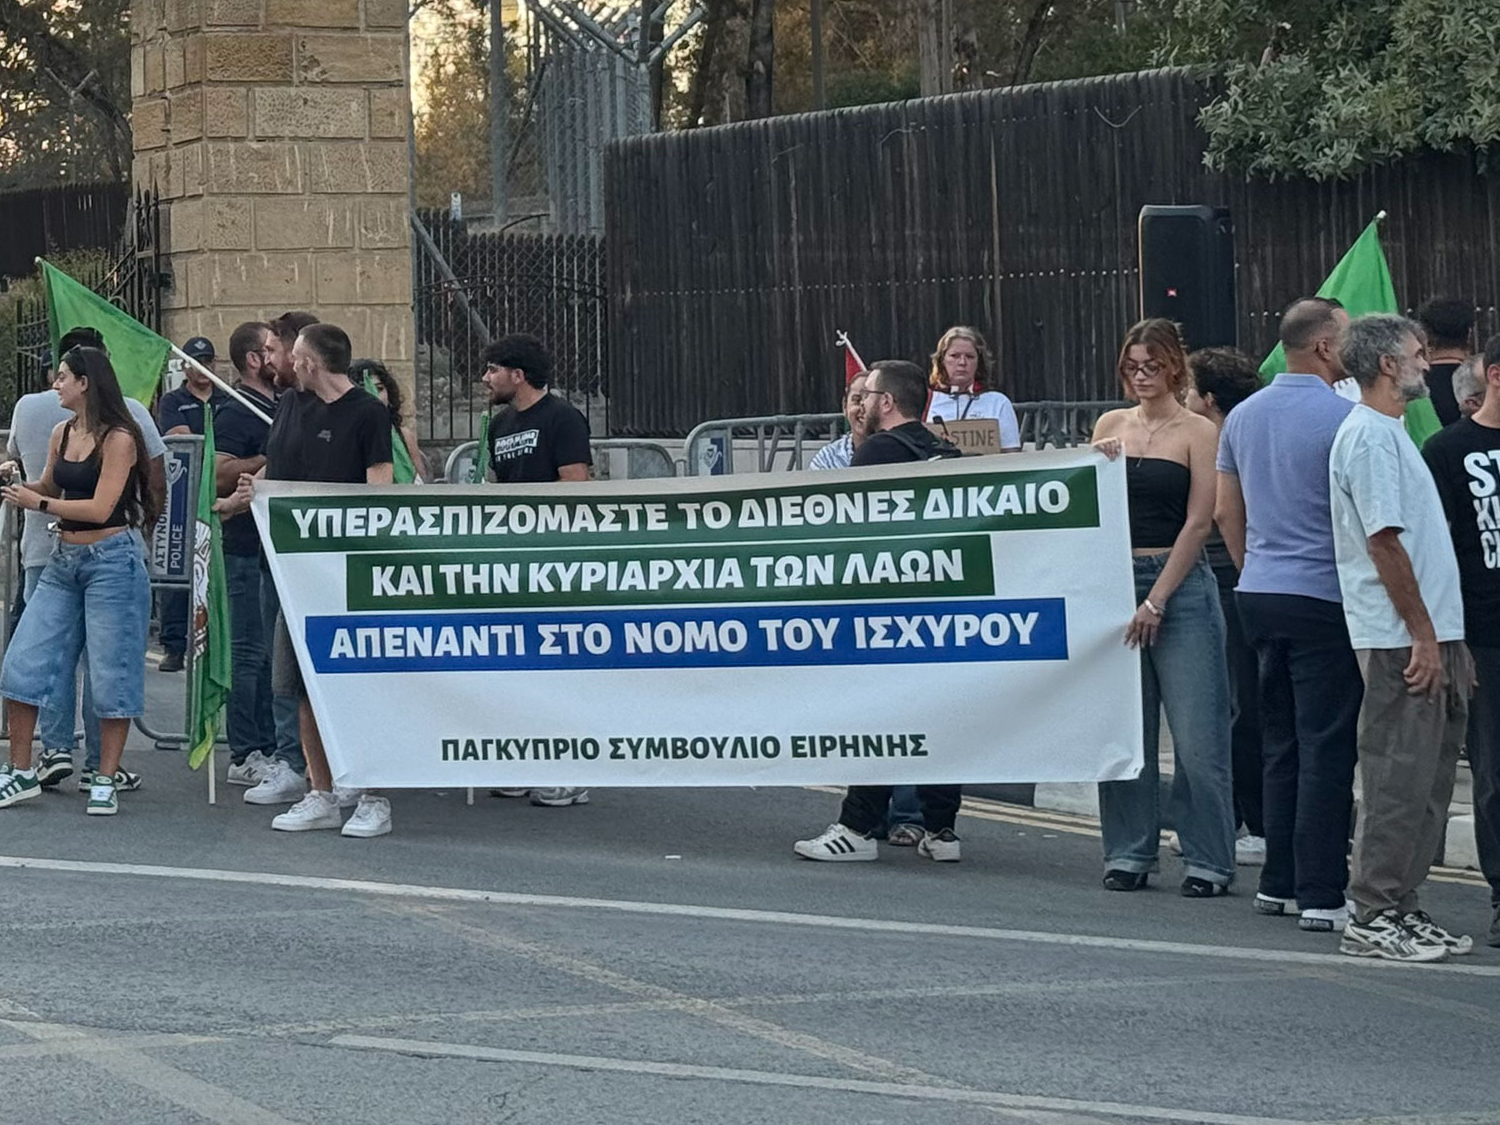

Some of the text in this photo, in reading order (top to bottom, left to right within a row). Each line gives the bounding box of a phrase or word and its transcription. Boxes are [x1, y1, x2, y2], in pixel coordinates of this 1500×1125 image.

[154, 489, 171, 569] ΑΣΤΥΝΟ
[291, 480, 1071, 539] ΥΠΕΡΑΣΠΙΖΟΜΑΣΤΕ ΤΟ ΔΙΕΘΝΕΣ ΔΙΚΑΙΟ
[170, 524, 184, 569] POLICE
[371, 548, 964, 597] ΚΑΙ ΤΗΝ ΚΥΡΙΑΡΧΙΑ ΤΩΝ ΛΑΩΝ
[329, 612, 1040, 659] ΑΠΕΝΑΝΤΙ ΣΤΟ ΝΟΜΟ ΤΟΥ ΙΣΧΥΡΟΥ
[441, 733, 929, 762] ΠΑΓΚΥΠΡΙΟ ΣΥΜΒΟΥΛΙΟ ΕΙΡΗΝΗΣ
